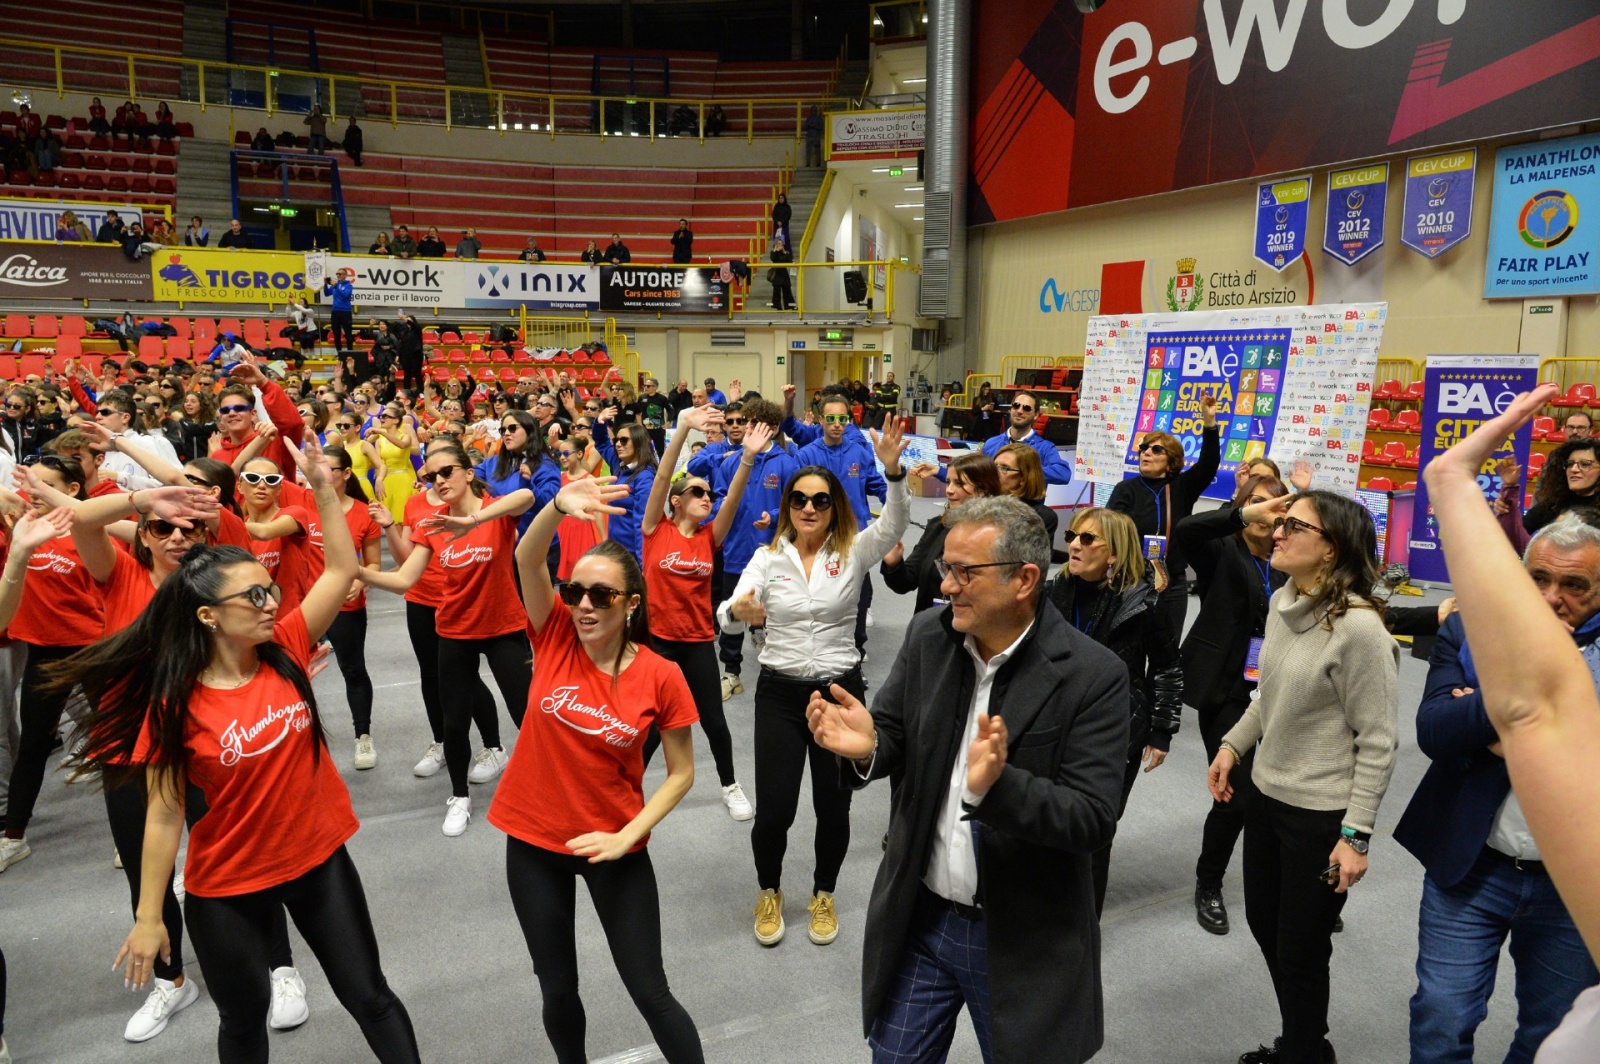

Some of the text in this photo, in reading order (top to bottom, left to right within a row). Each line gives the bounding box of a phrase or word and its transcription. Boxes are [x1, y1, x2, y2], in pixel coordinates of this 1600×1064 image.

[1415, 156, 1466, 173] CEV CUP
[1336, 169, 1379, 186] CEV CUP
[1510, 164, 1596, 185] LA MALPENSA
[1292, 187, 1303, 195] CUP
[1428, 198, 1446, 207] CEV
[1346, 209, 1362, 218] CEV
[1417, 211, 1455, 227] 2010
[1338, 218, 1370, 233] 2012
[1417, 224, 1453, 235] WINNER
[1266, 231, 1296, 246] 2019
[1338, 231, 1369, 241] WINNER
[1267, 243, 1294, 253] WINNER
[1497, 252, 1590, 272] FAIR PLAY
[205, 269, 306, 290] TIGROS
[1180, 277, 1188, 287] B
[1209, 269, 1257, 289] Città di
[1496, 273, 1589, 286] per uno sport vincente
[161, 288, 171, 296] IL
[177, 288, 228, 298] FRESCO
[235, 288, 254, 298] PIÙ
[384, 294, 400, 303] per
[402, 292, 408, 301] il
[411, 293, 440, 302] lavoro
[624, 289, 681, 298] Cars since 1963
[1062, 289, 1100, 312] AGESP
[1180, 289, 1188, 297] B
[1208, 286, 1297, 307] Busto Arsizio
[1181, 344, 1239, 377] BAè
[1437, 382, 1518, 415] BAè
[1171, 417, 1229, 438] SPOT
[440, 543, 493, 568] Flamboyan
[659, 551, 713, 575] Flamboyan
[540, 685, 639, 736] Flamboyan
[605, 731, 636, 748] Club
